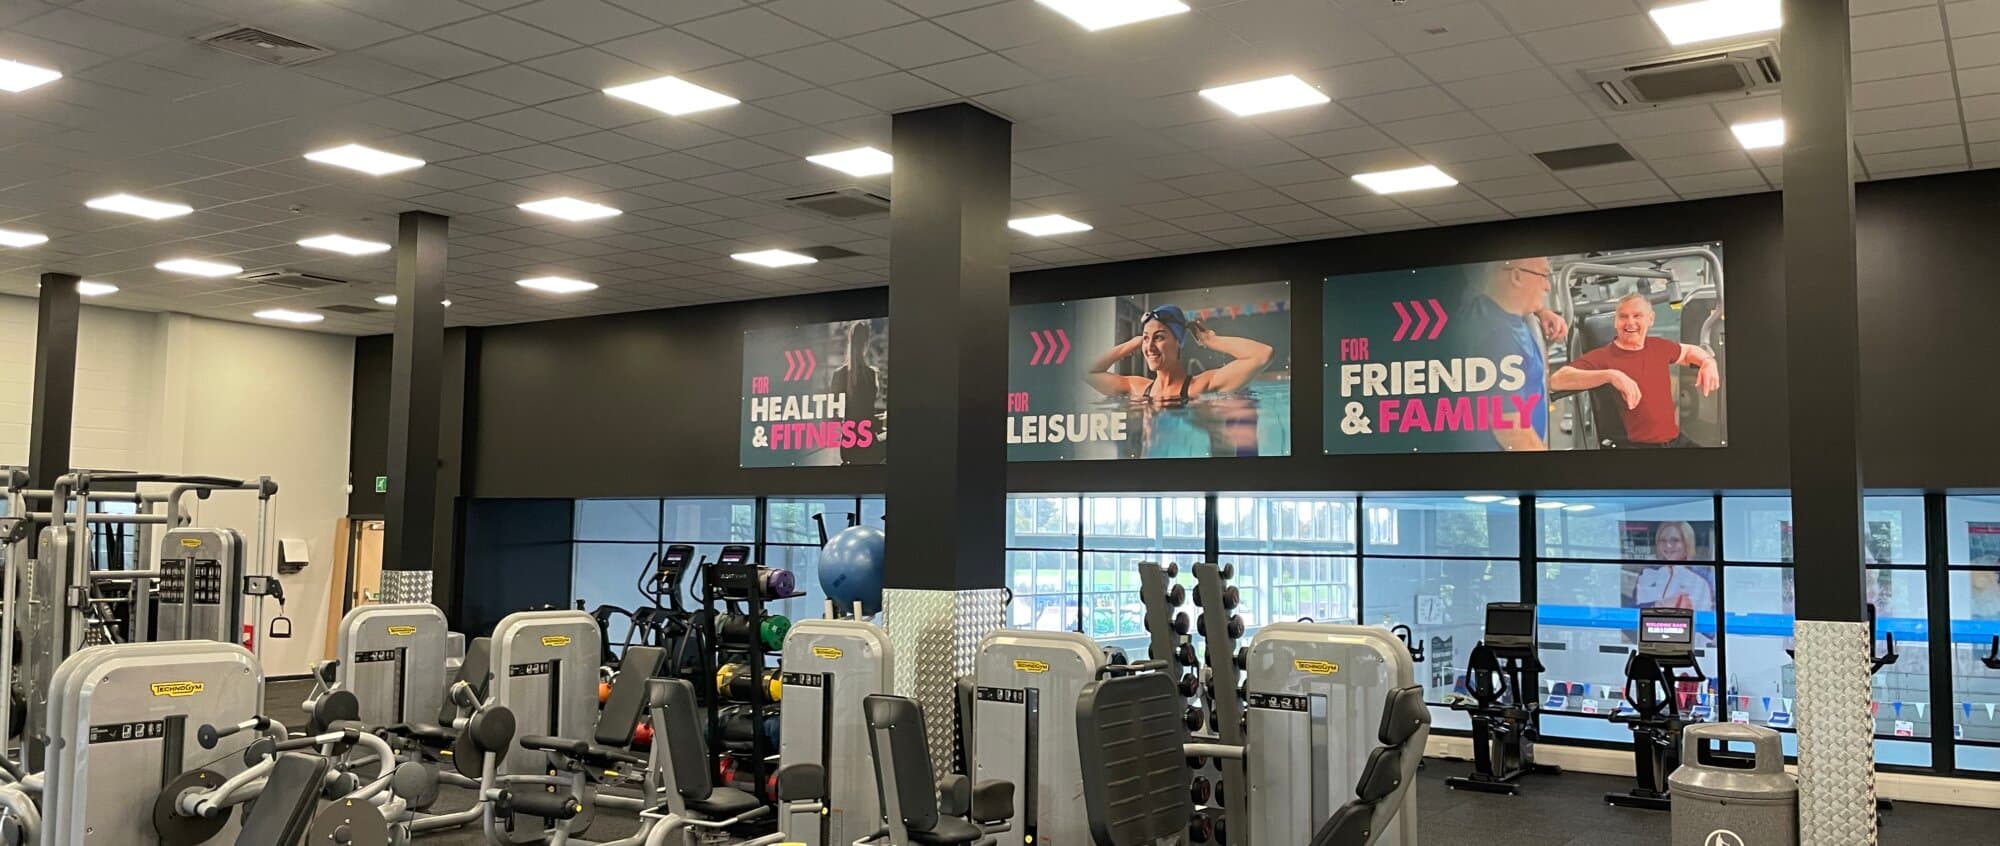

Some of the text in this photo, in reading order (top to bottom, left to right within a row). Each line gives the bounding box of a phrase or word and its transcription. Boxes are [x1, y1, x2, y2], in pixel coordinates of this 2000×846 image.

[1340, 338, 1369, 362] FOR
[752, 376, 769, 394] FOR
[1340, 354, 1526, 397] FRIENDS
[751, 392, 846, 422] HEALTH
[1007, 391, 1029, 413] FOR
[1340, 393, 1542, 435] & FAMILY
[752, 419, 873, 450] & FITNESS
[1006, 411, 1128, 444] LEISURE
